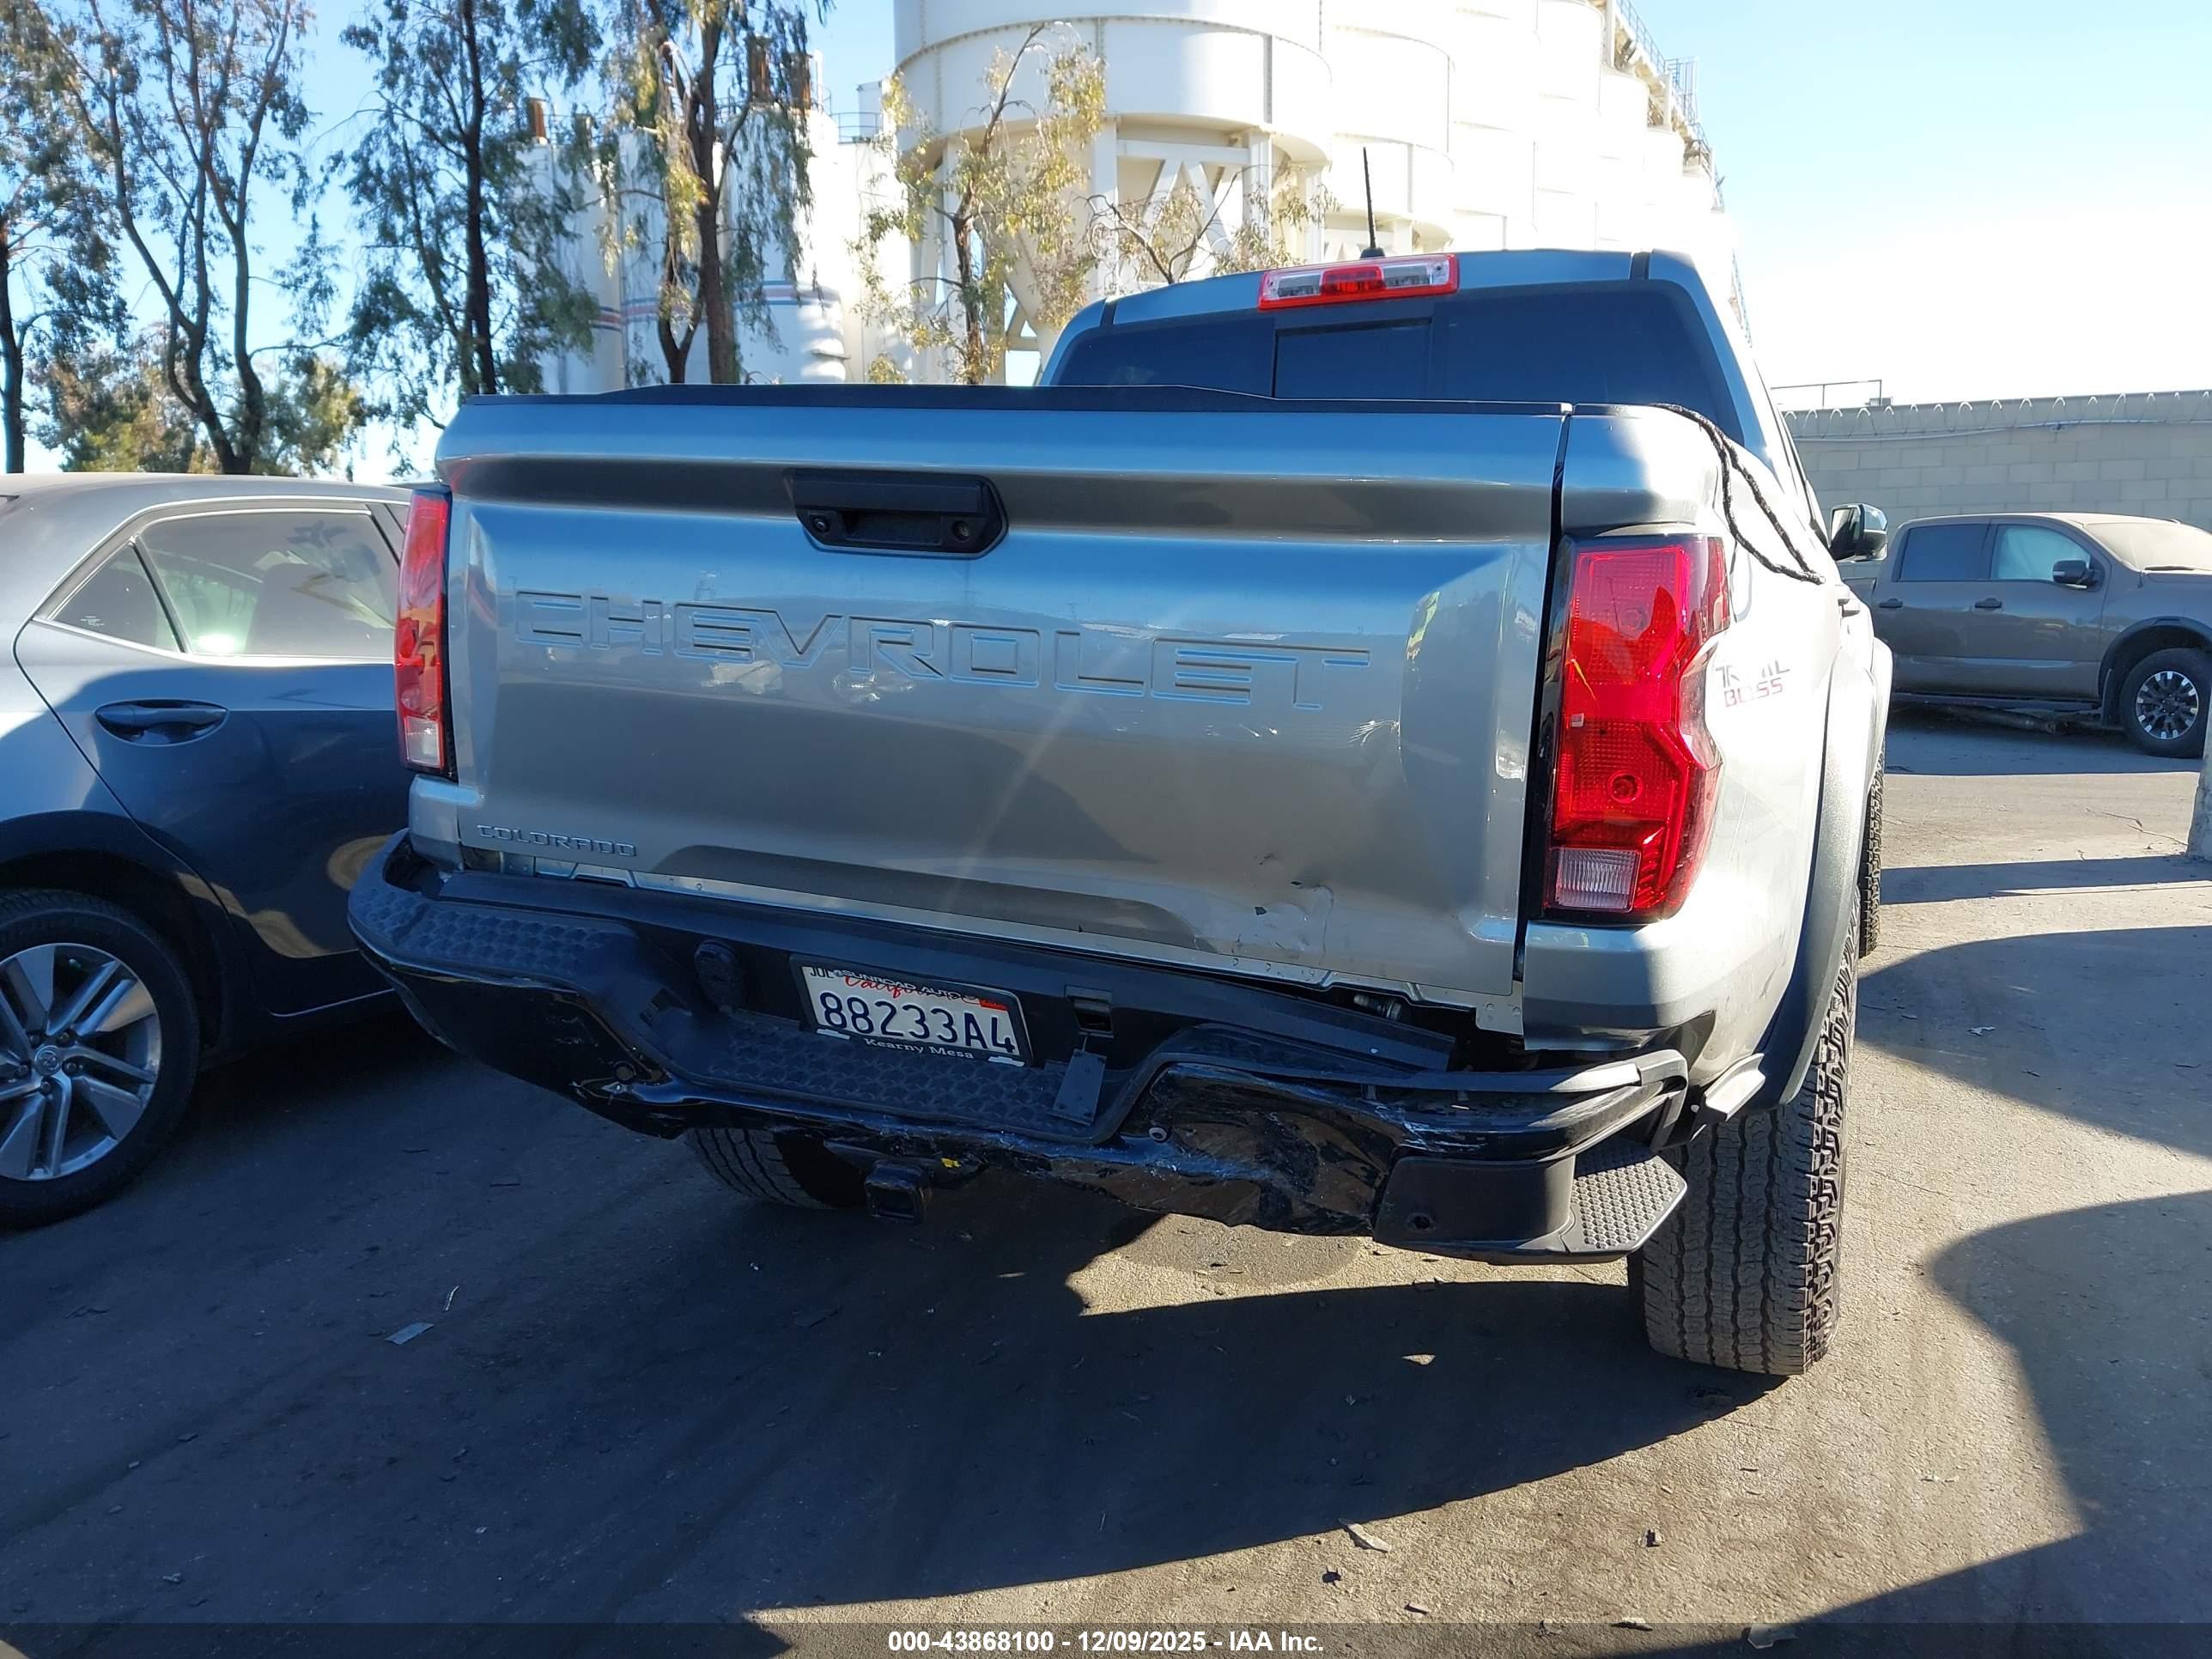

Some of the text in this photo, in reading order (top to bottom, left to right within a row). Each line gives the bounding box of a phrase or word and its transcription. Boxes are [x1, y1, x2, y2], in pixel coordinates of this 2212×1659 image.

[515, 591, 1370, 710] CHEVROLET
[1716, 659, 1790, 688] TRIL
[477, 824, 637, 857] COLORADO
[810, 967, 835, 979] JUL
[842, 969, 916, 990] SUNROAD
[819, 992, 1015, 1053] 88233A4
[864, 1037, 975, 1059] Kearny Mesa
